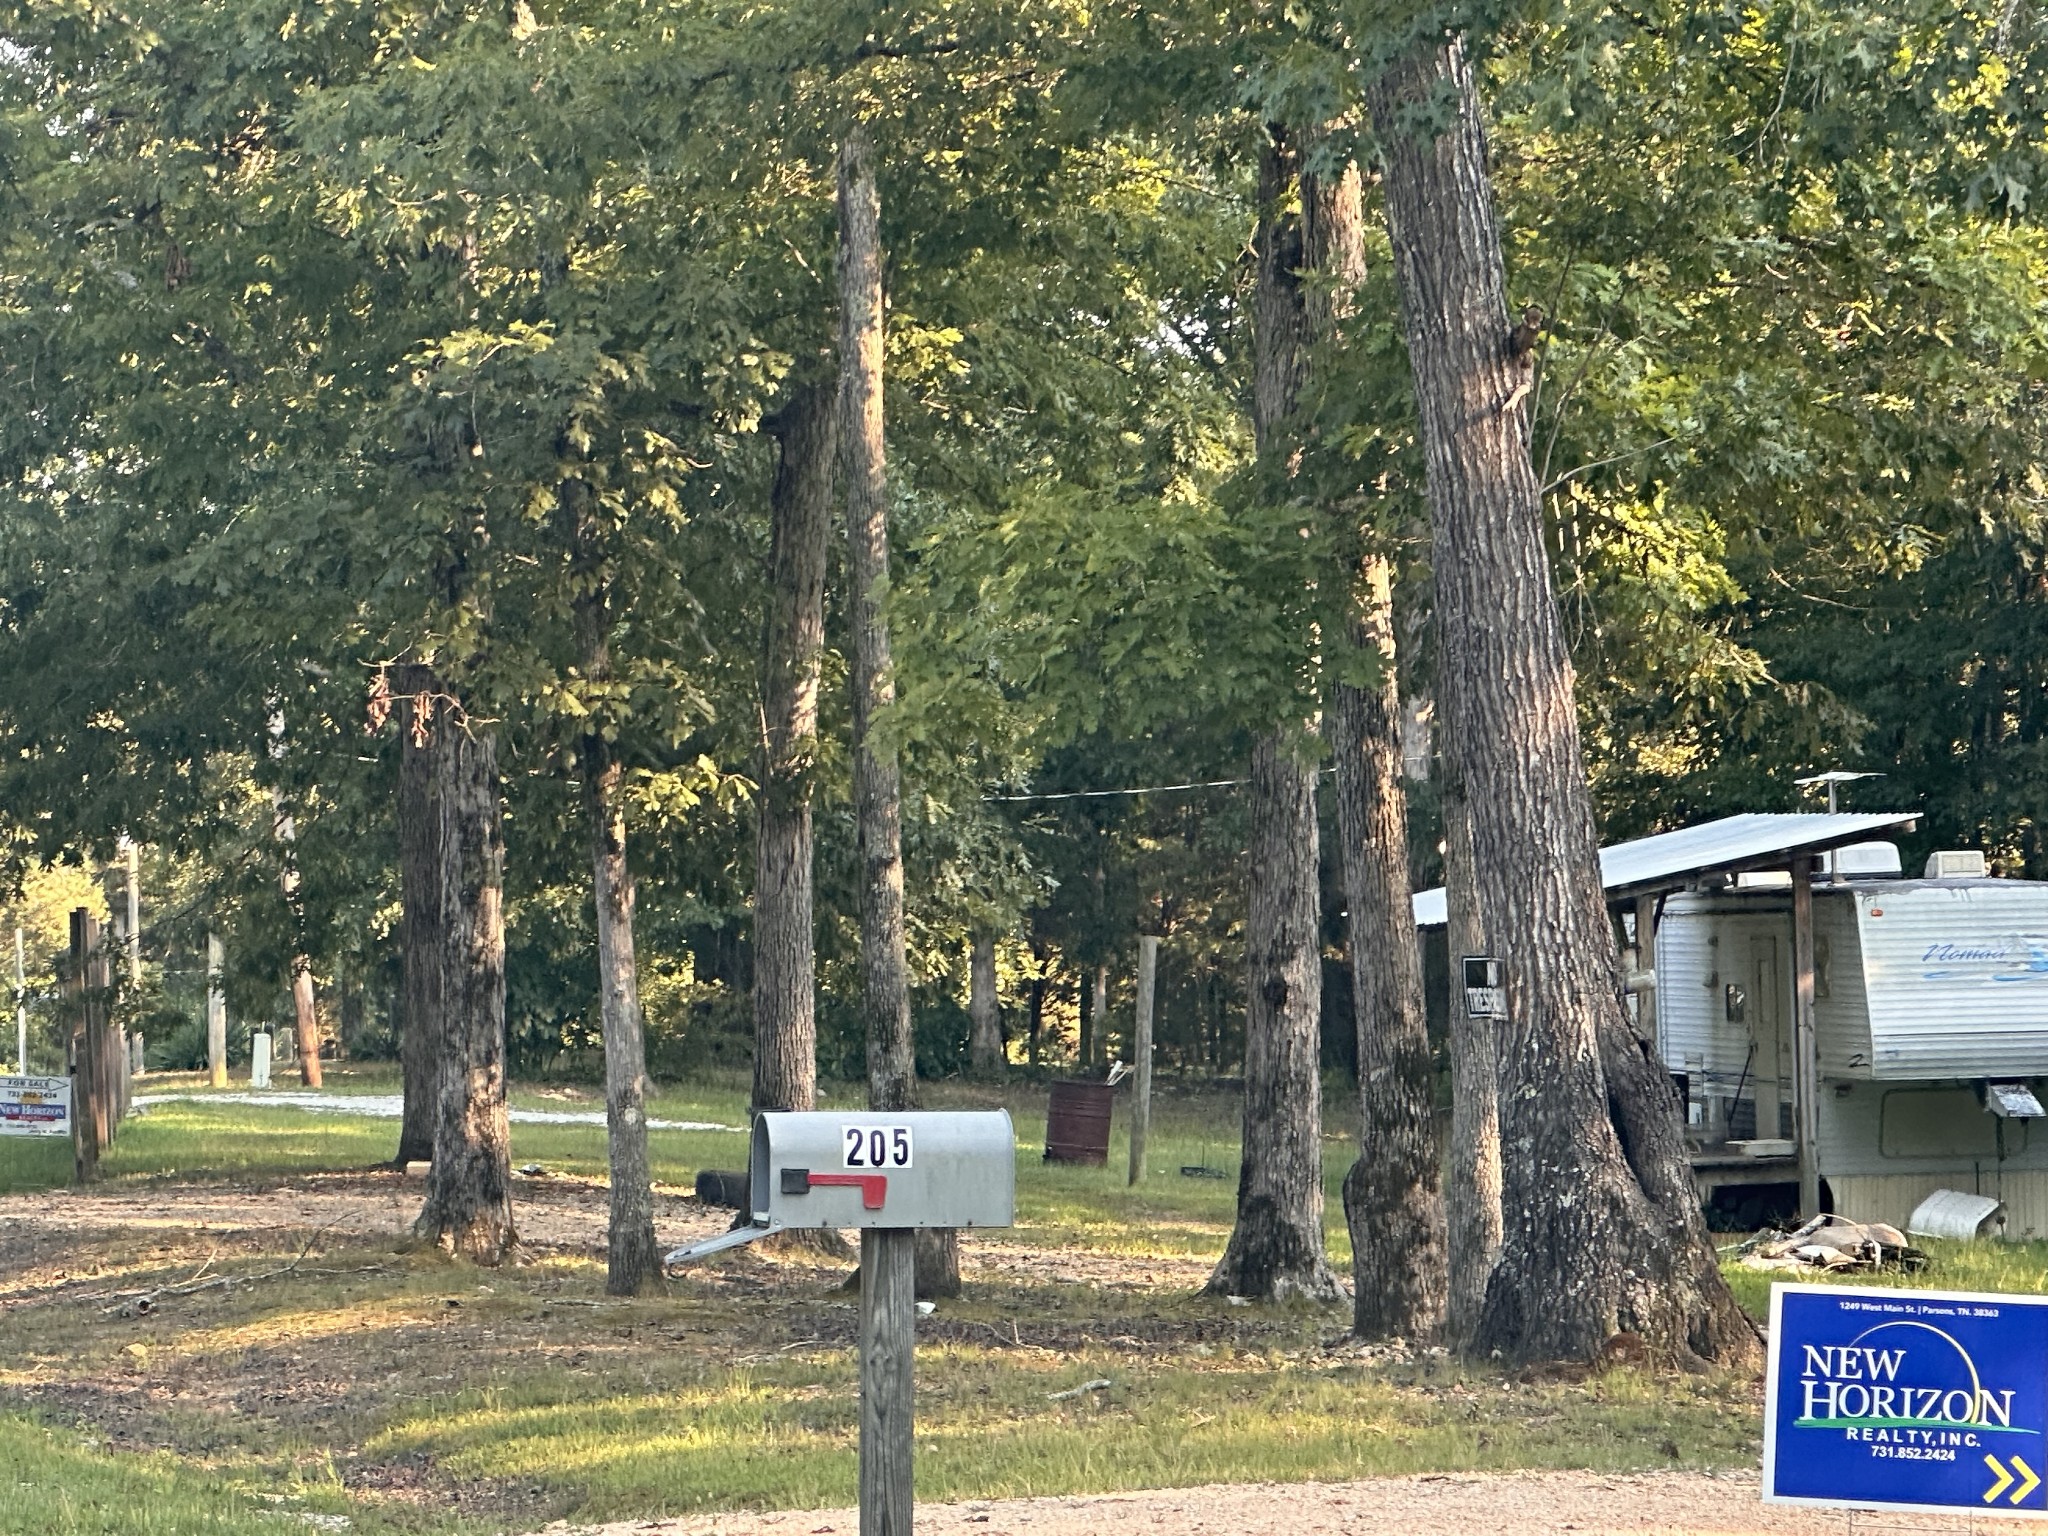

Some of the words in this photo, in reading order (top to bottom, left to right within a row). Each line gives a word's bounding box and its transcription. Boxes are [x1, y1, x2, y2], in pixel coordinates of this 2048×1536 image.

[846, 1128, 909, 1167] 205
[1839, 1302, 1861, 1310] 1249
[1861, 1303, 1883, 1311] West
[1884, 1304, 1904, 1312] Main
[1801, 1345, 1907, 1381] NEW
[1798, 1379, 2016, 1427] HORIZON
[1871, 1445, 1956, 1461] 731.852.2424
